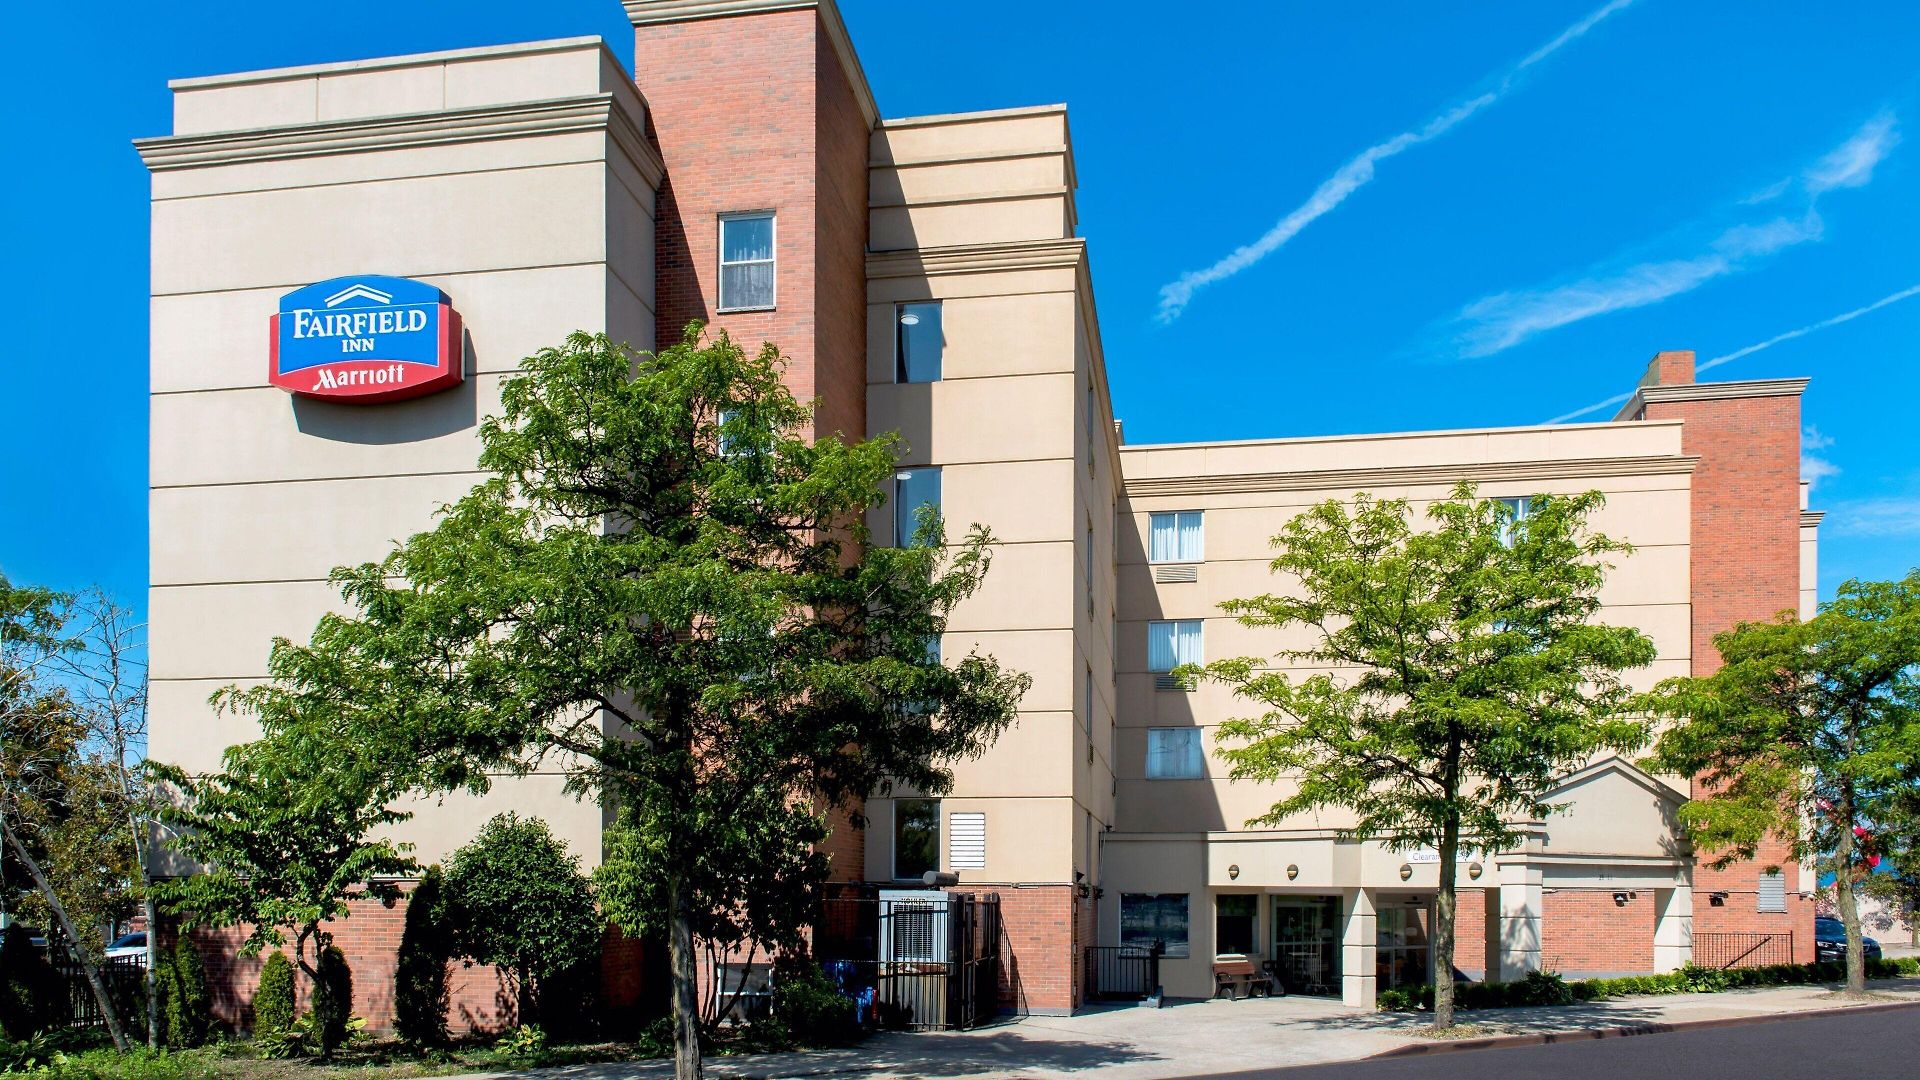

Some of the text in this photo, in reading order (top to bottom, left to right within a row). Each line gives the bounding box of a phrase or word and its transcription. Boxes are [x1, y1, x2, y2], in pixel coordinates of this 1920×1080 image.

[293, 309, 427, 338] FAIRFIELD
[342, 338, 375, 352] INN
[312, 364, 404, 391] Marriott
